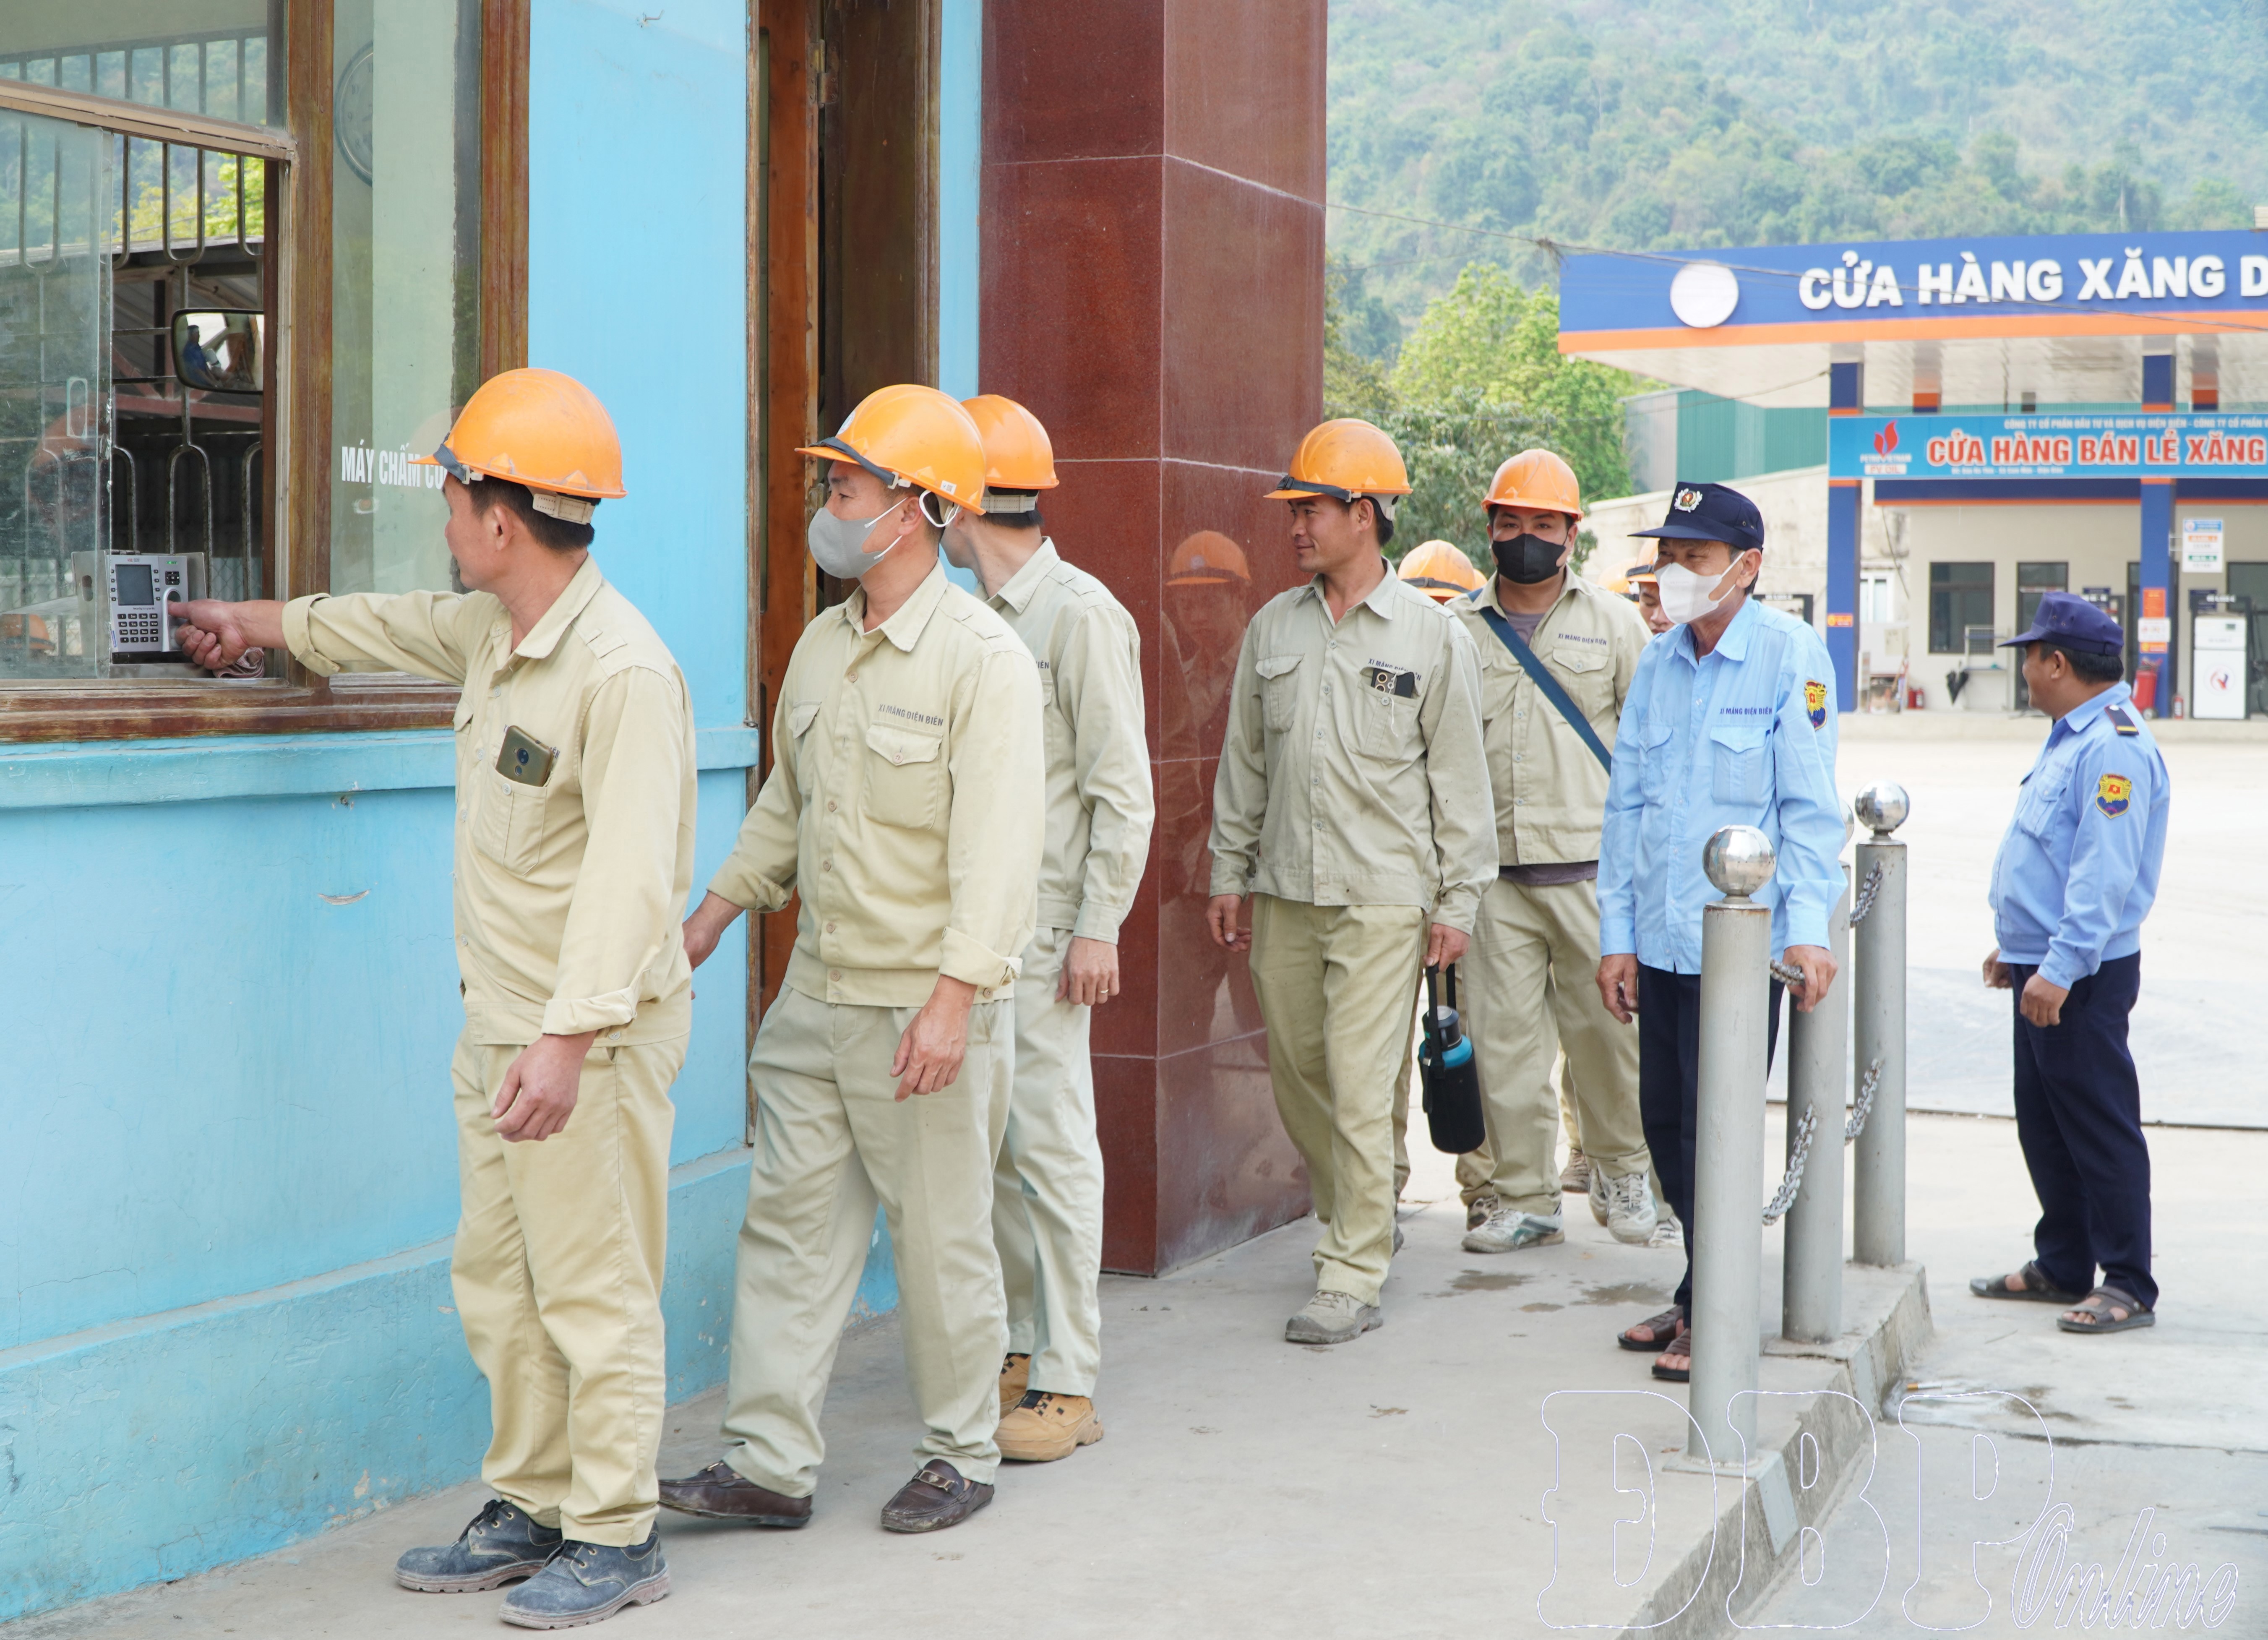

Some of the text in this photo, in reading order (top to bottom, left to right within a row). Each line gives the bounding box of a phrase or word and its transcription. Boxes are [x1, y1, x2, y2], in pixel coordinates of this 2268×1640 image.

[1799, 250, 1903, 310] CỬA
[1918, 251, 2063, 305] HÀNG
[2077, 246, 2226, 300] XĂNG
[342, 439, 374, 483] MÁY
[379, 443, 420, 487] CHẤM
[1927, 428, 2266, 466] CỬA HÀNG BÁN LẺ XĂNG
[1036, 660, 1049, 669] IÊN
[925, 715, 944, 726] BIÊN
